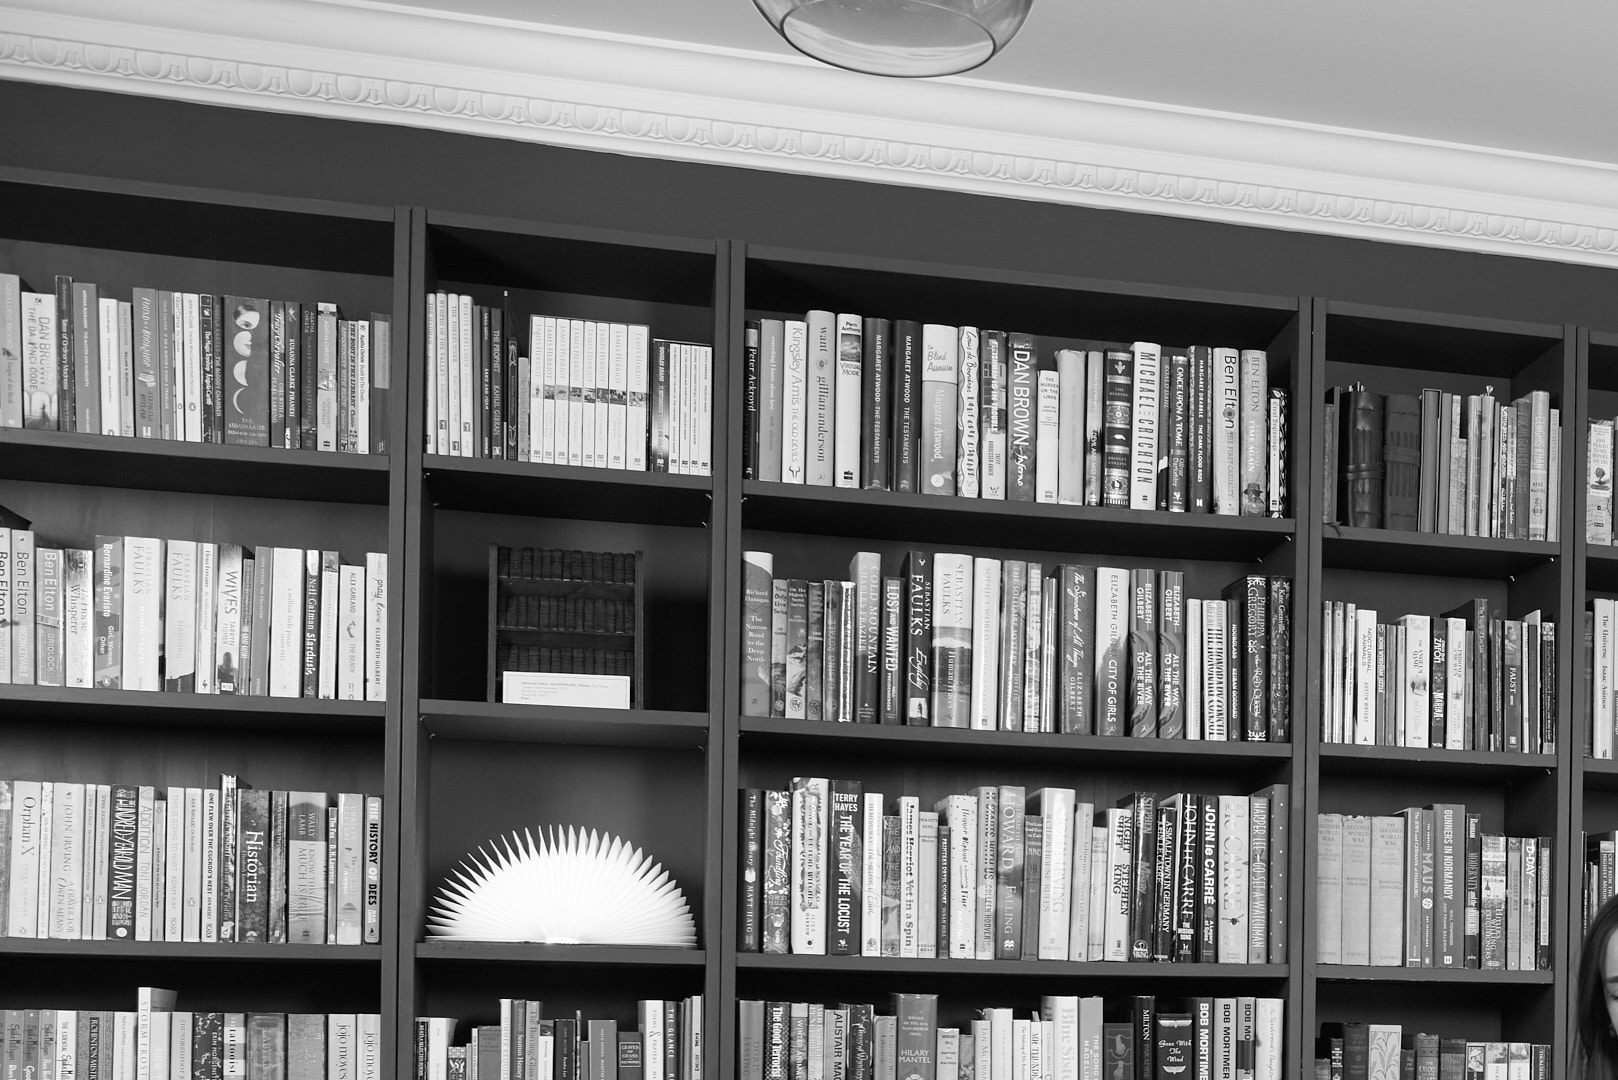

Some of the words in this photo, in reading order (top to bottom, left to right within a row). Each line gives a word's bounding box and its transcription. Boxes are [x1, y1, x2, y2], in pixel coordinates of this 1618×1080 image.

[39, 317, 50, 340] DAN
[820, 327, 828, 352] want
[39, 343, 51, 386] BROWN
[789, 328, 803, 373] Kingsley
[1014, 350, 1030, 384] DAN
[1139, 352, 1156, 408] MICHAEL
[1176, 367, 1184, 389] ONCE
[1224, 355, 1237, 384] Ben
[792, 375, 802, 405] Amis
[816, 376, 828, 411] gillian
[1176, 391, 1184, 414] UPON
[1013, 387, 1029, 445] BROWN
[1223, 389, 1237, 429] Elton
[817, 413, 827, 462] anderson
[902, 422, 910, 464] TESTAMENTS
[1137, 419, 1154, 484] CRICHTON
[1016, 446, 1028, 486] Inferno
[44, 552, 56, 576] Ben
[103, 544, 112, 585] Bernardine
[44, 579, 57, 611] Elton
[103, 586, 112, 617] Evaristo
[887, 586, 899, 613] LOST
[911, 574, 924, 636] FAULKS
[1248, 587, 1257, 637] GREGORY
[1257, 597, 1265, 637] PHILIPPA
[886, 626, 899, 670] WANTED
[1137, 652, 1144, 662] TO
[909, 647, 929, 691] Engleby
[1108, 660, 1117, 680] CITY
[1108, 682, 1117, 694] OF
[1107, 697, 1116, 722] GIRLS
[370, 803, 378, 820] THE
[840, 815, 852, 832] THE
[1205, 805, 1215, 841] JOHN
[1252, 803, 1266, 835] HARPER
[1444, 810, 1453, 843] GUNNERS
[139, 806, 152, 853] ADDITION
[369, 823, 378, 864] HISTORY
[1115, 815, 1124, 848] SHIFT
[1123, 816, 1131, 853] NIGHT
[1252, 838, 1265, 850] LEE
[839, 836, 851, 859] YEAR
[1205, 845, 1215, 855] le
[246, 831, 263, 903] Historian
[369, 867, 377, 881] OF
[838, 863, 851, 875] OF
[1113, 864, 1121, 894] KING
[1204, 859, 1215, 904] CARRÉ
[1422, 853, 1433, 893] MAUS
[1443, 856, 1454, 899] NORMANDY
[368, 884, 377, 905] BEES
[838, 878, 850, 895] THE
[1121, 864, 1129, 915] STEPHEN
[837, 898, 850, 933] LOCUST
[773, 1007, 783, 1022] The
[1200, 1003, 1208, 1026] BOB
[90, 1020, 98, 1058] ROHINTON
[337, 1023, 350, 1044] jojo
[772, 1023, 783, 1043] Good
[834, 1013, 842, 1058] ALISTAIR
[336, 1047, 347, 1080] moyes
[772, 1045, 782, 1077] Terrorist
